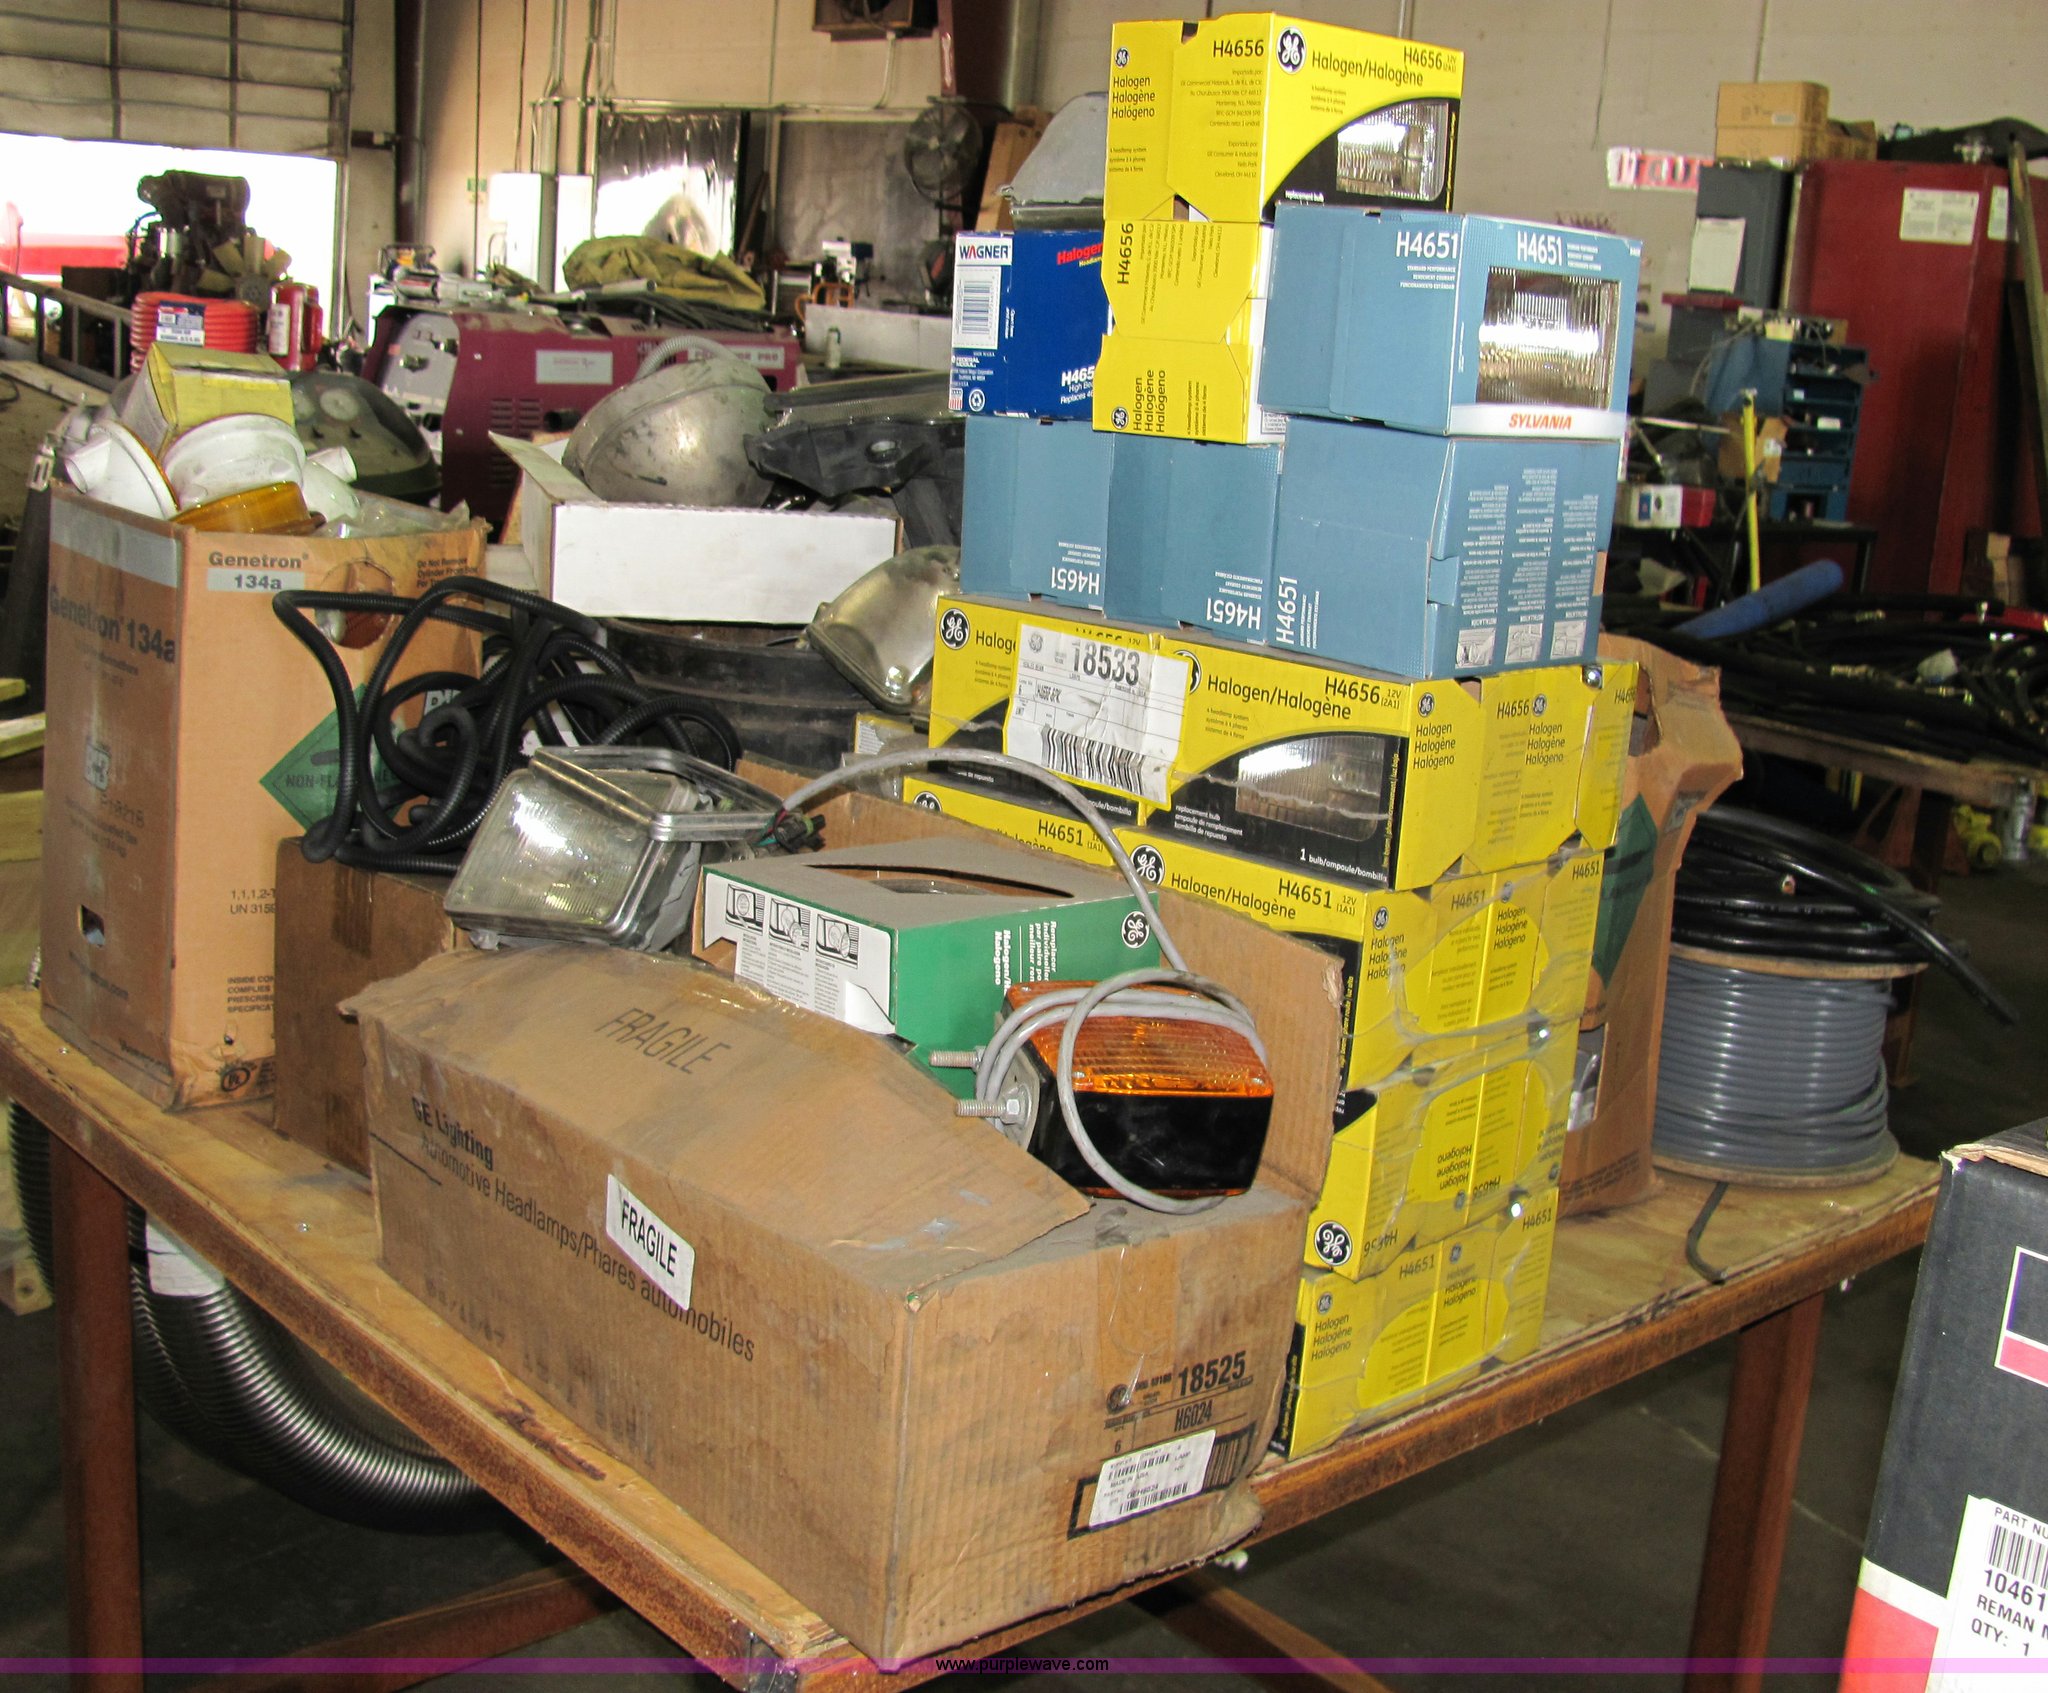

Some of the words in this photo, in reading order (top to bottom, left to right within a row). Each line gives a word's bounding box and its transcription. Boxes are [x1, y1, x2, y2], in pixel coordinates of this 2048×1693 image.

[1213, 40, 1264, 58] H4656
[1404, 46, 1443, 71] H4656
[1312, 50, 1423, 86] Halogen/Halogène
[1113, 76, 1150, 90] Halogen
[1112, 89, 1155, 106] Halogène
[1112, 104, 1155, 121] Halógeno
[959, 244, 1009, 259] WAGNER
[1117, 223, 1134, 285] H4656
[1395, 231, 1459, 259] H4651
[1516, 230, 1563, 266] H4651
[1069, 381, 1082, 393] High
[1133, 377, 1144, 431] Halogen
[1144, 369, 1156, 432] Halogène
[1155, 370, 1167, 433] Halógeno
[1509, 412, 1573, 430] SYLVANIA
[234, 574, 282, 590] 134a
[1051, 566, 1100, 595] H4651
[1206, 597, 1261, 630] H4651
[1276, 576, 1298, 644] H4651
[126, 618, 177, 664] 134a
[1071, 639, 1140, 686] 18533
[1207, 675, 1351, 721] Halogen/Halogène
[1325, 676, 1381, 705] H4656
[1387, 688, 1402, 699] 12V
[1496, 699, 1530, 719] H4656
[1416, 722, 1452, 739] Halogen
[1529, 722, 1563, 738] Halogen
[1414, 736, 1456, 756] Halogène
[1527, 736, 1565, 754] Halogène
[1413, 753, 1455, 772] Halógeno
[1525, 751, 1564, 767] Halógeno
[1175, 805, 1208, 817] replacement
[1208, 811, 1221, 821] bulb
[1175, 814, 1198, 826] ampoule
[1199, 818, 1206, 826] de
[1206, 821, 1243, 836] remplacement
[1037, 819, 1084, 847] H4651
[1300, 848, 1306, 861] 1
[1309, 854, 1388, 883] bulb/ampoule/bombilla
[1572, 863, 1601, 881] H4651
[1171, 872, 1296, 920] Halogen/Halogène
[1278, 878, 1332, 909] H4651
[1342, 896, 1357, 906] 12V
[1451, 889, 1486, 911] H4651
[230, 904, 247, 915] UN
[1497, 906, 1527, 921] Halogen
[1495, 919, 1528, 936] Halogène
[1048, 921, 1058, 973] Remplacer
[1371, 934, 1405, 950] Halogen
[1494, 933, 1526, 950] Halógeno
[227, 985, 271, 994] COMPLIES
[595, 1007, 731, 1075] FRAGILE
[436, 1109, 493, 1171] Lighting
[1440, 1173, 1469, 1190] Halogen
[1522, 1207, 1552, 1232] H4651
[422, 1132, 490, 1197] Automotive
[495, 1178, 636, 1291] Headlamps/Phares
[641, 1279, 755, 1362] automobiles
[621, 1200, 677, 1277] FRAGILE
[1399, 1255, 1435, 1280] H4651
[1443, 1286, 1477, 1308] Halógeno
[1315, 1314, 1350, 1333] Halogen
[1313, 1326, 1353, 1347] Halogène
[1311, 1340, 1352, 1361] Halógeno
[1178, 1350, 1246, 1396] 18525
[1174, 1400, 1212, 1432] H6024
[1994, 1506, 2028, 1529] PART
[1984, 1568, 2047, 1612] 10461
[1976, 1594, 2035, 1633] REMAN
[1971, 1617, 2008, 1647] QTY:
[2023, 1643, 2030, 1656] 1
